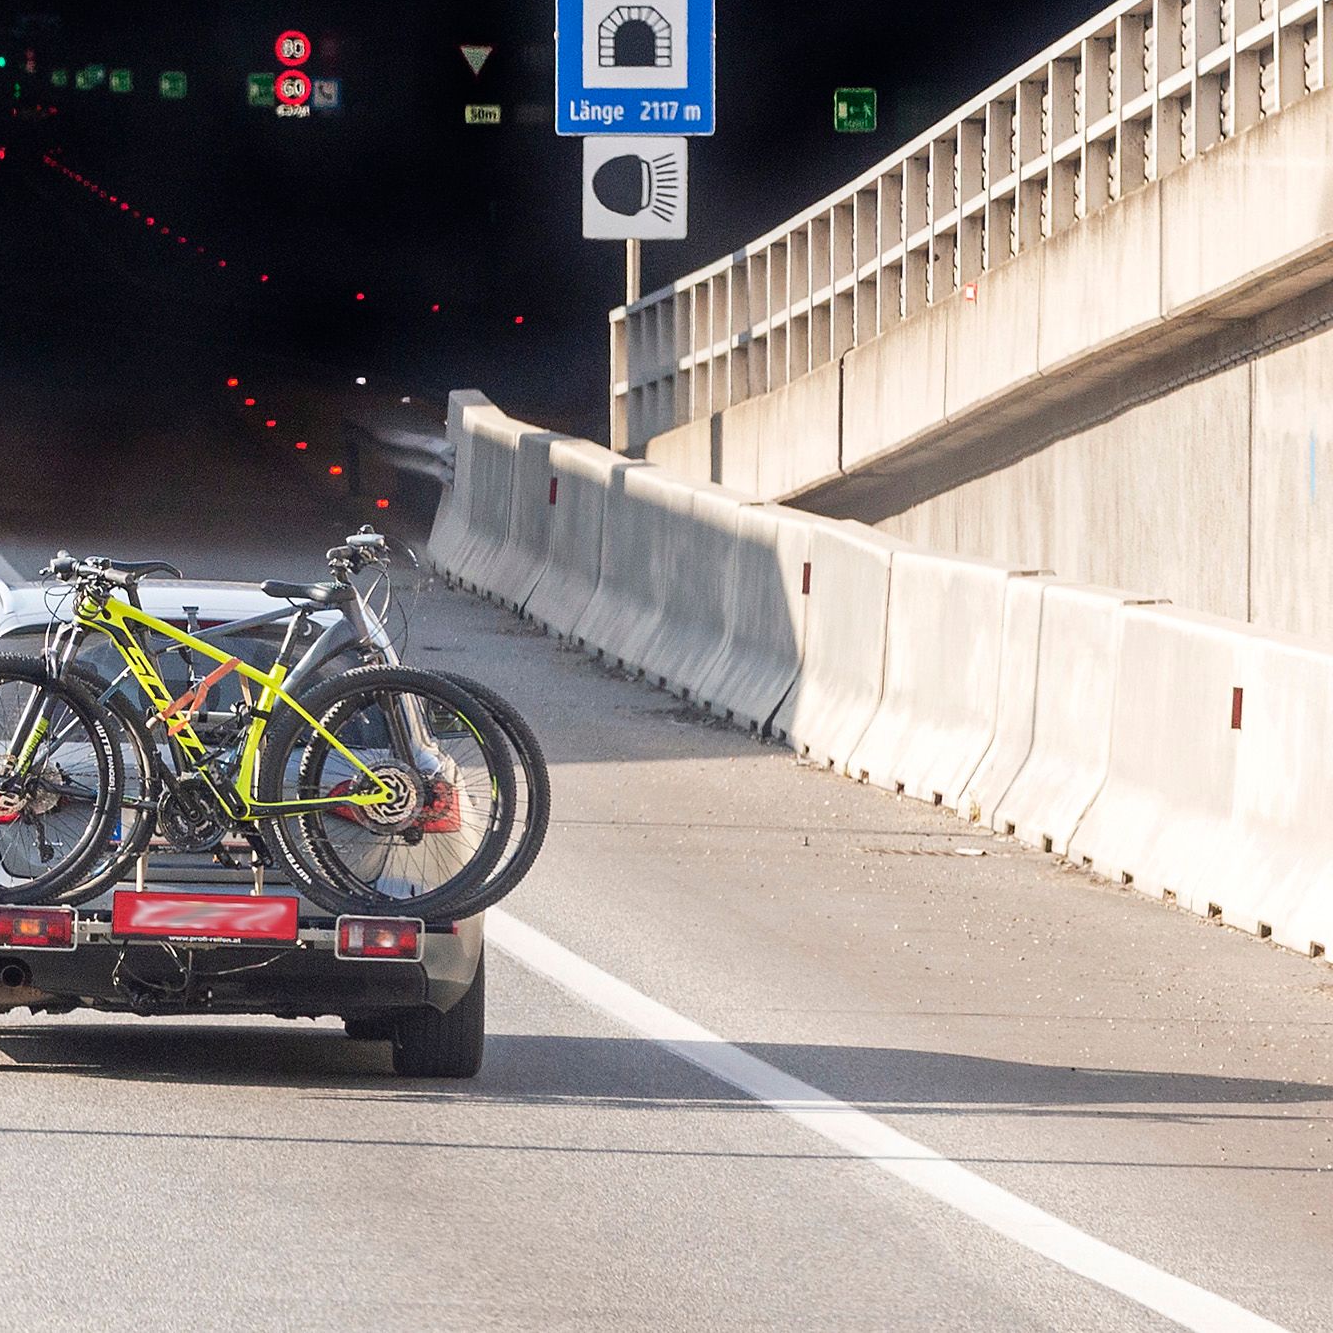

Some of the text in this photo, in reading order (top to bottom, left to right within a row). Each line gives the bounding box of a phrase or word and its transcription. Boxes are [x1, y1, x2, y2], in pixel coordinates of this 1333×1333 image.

[281, 38, 305, 59] 80
[280, 78, 306, 98] 60
[569, 99, 702, 126] Länge 2117 m
